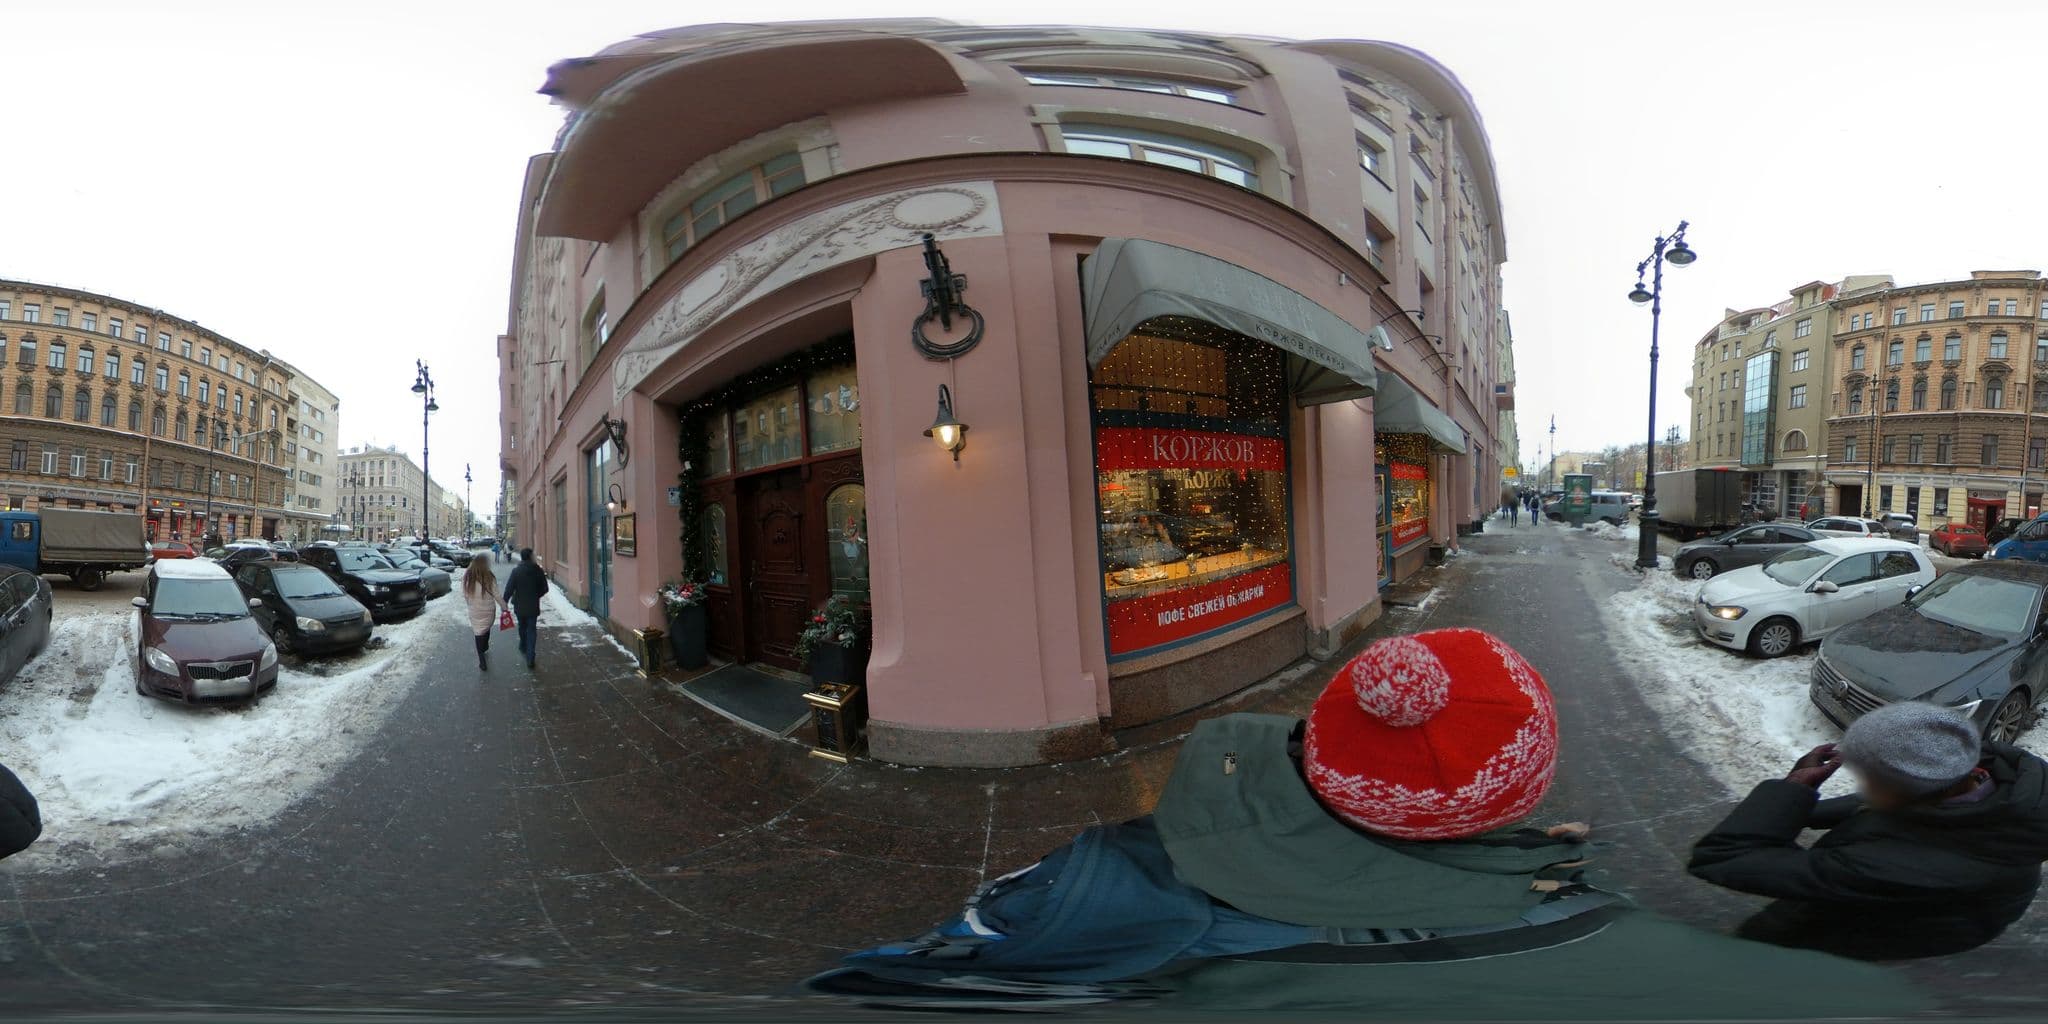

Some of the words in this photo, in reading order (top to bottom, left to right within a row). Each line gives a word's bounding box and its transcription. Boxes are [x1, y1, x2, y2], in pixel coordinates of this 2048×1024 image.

[1255, 322, 1305, 350] КОРЖОВ
[1152, 434, 1255, 463] КОРЖОВ
[1157, 606, 1185, 627] КОФЕ
[1187, 594, 1225, 619] СВЕЖЕЙ
[1227, 584, 1265, 607] ОБЖАРКИ
